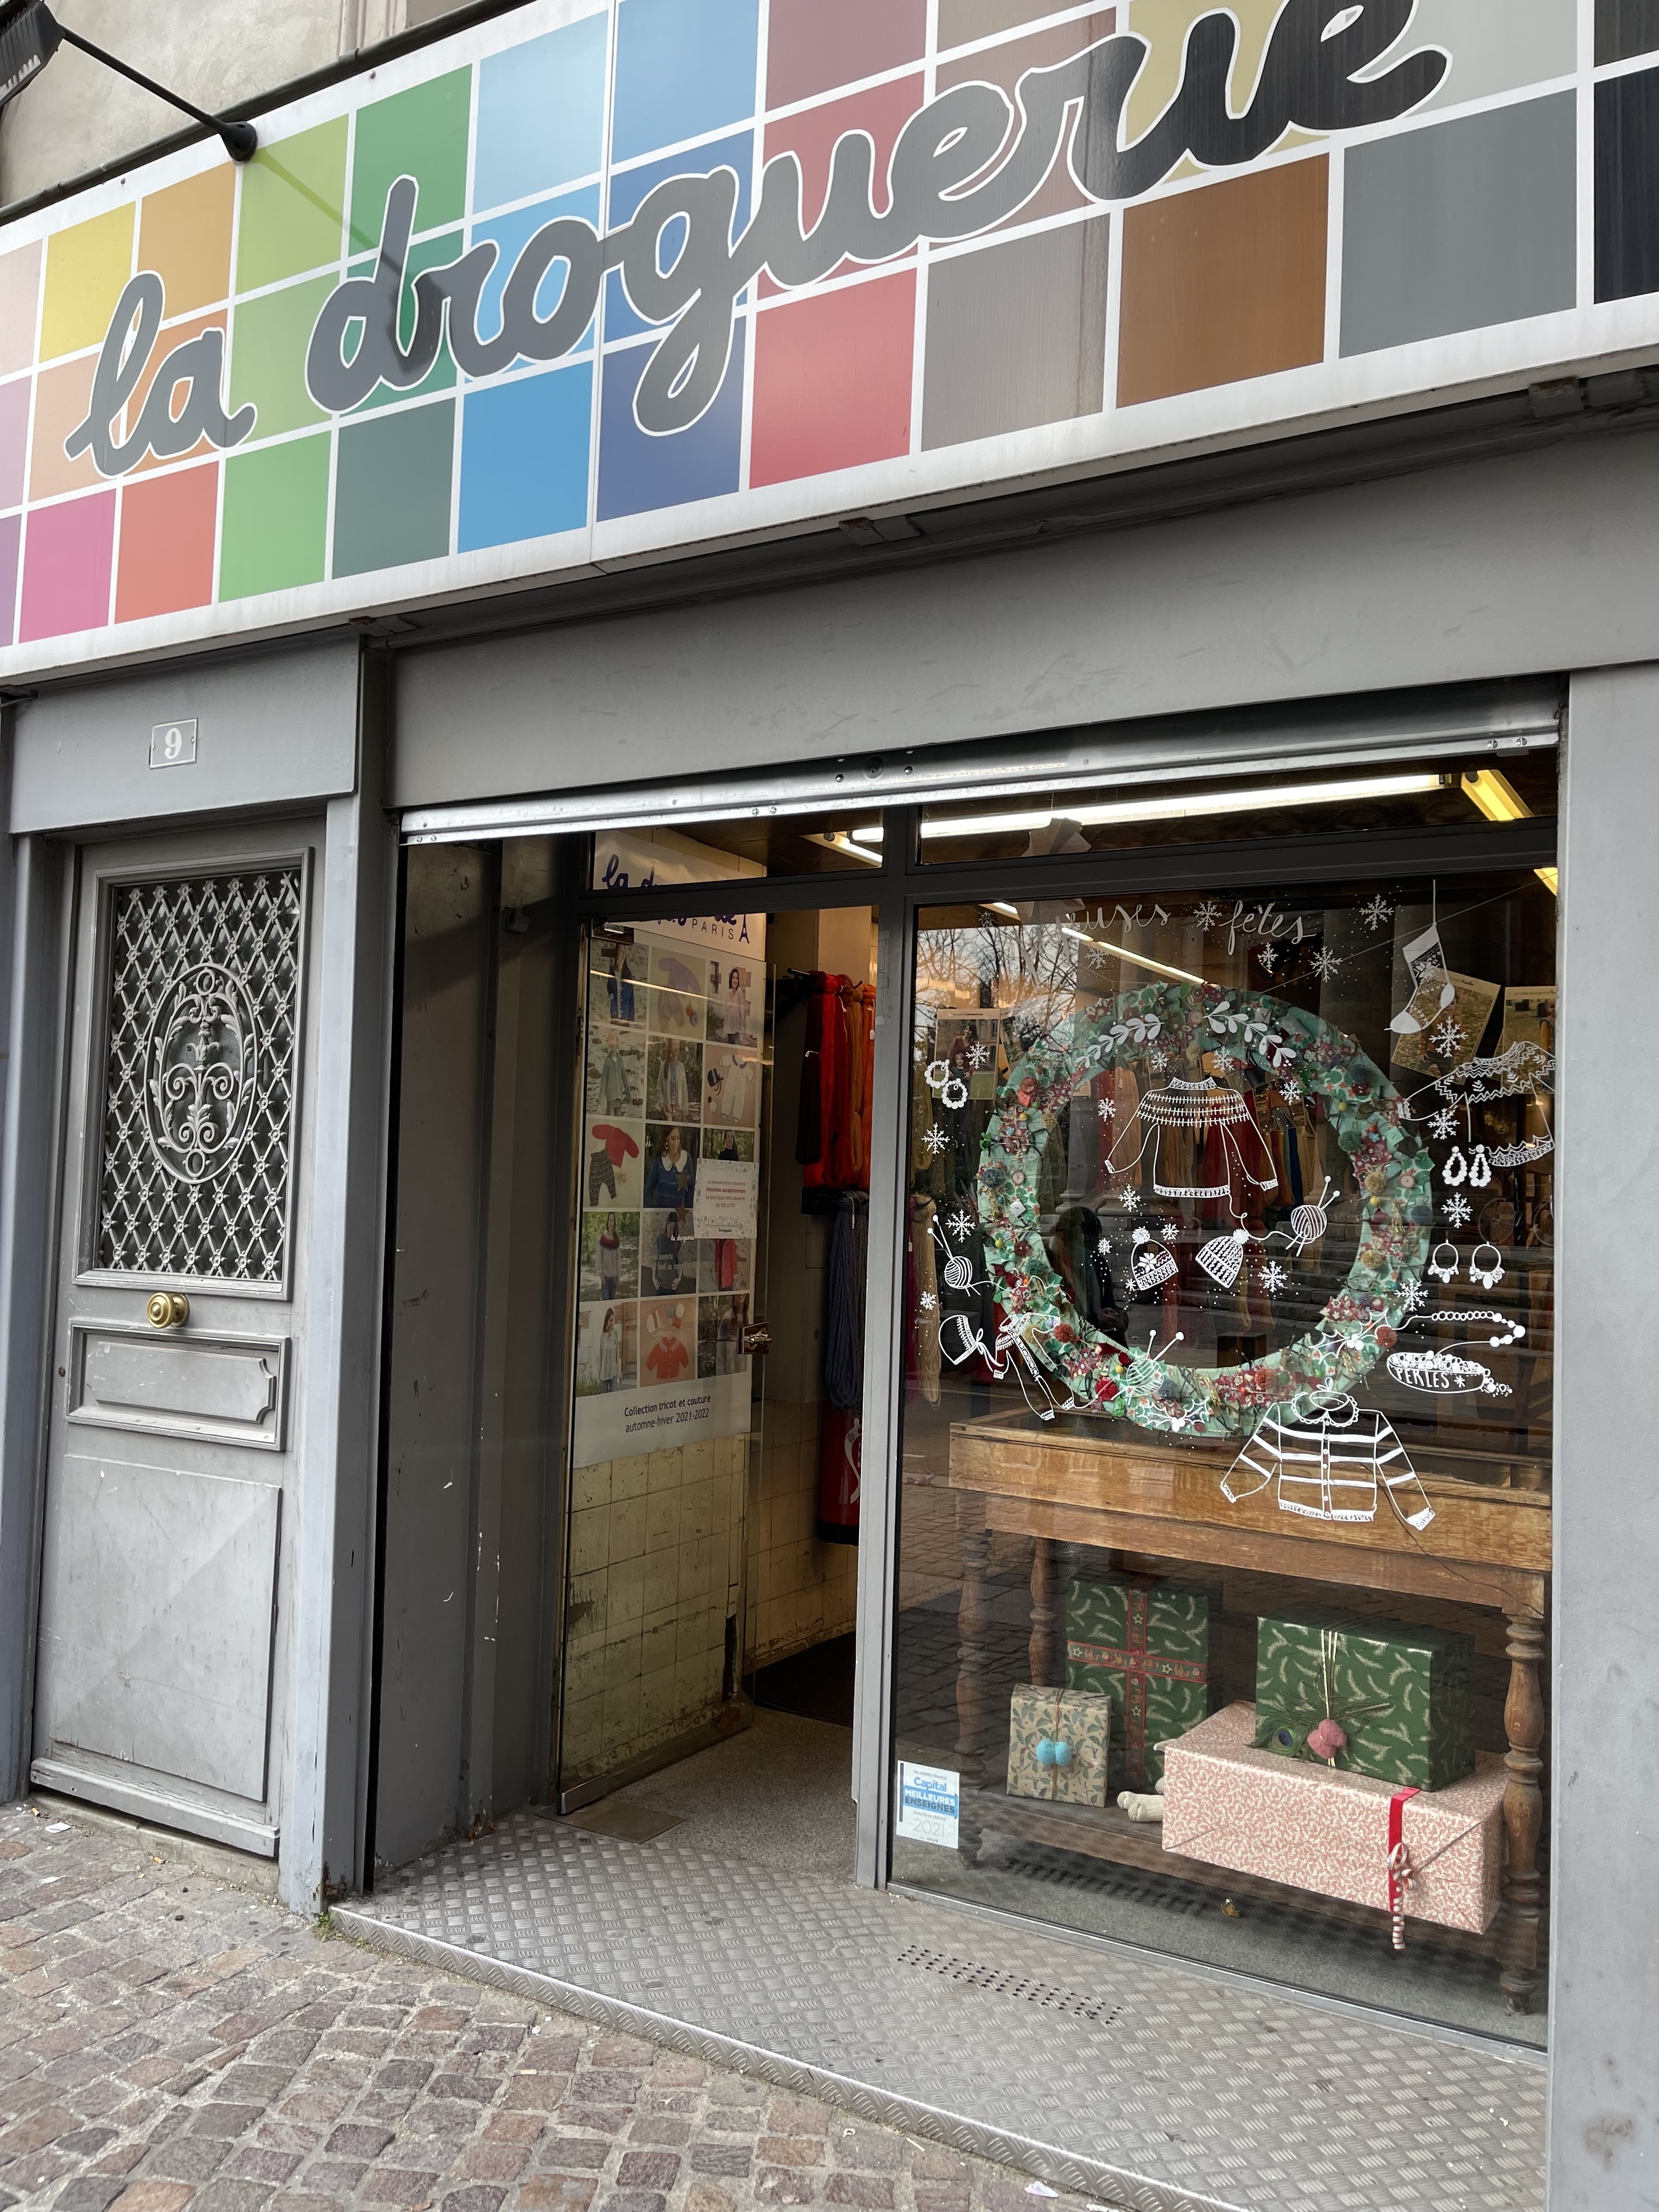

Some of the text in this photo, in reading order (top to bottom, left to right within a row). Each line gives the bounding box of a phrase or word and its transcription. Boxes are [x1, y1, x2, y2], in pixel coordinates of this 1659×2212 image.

[64, 270, 257, 478] la
[165, 727, 182, 759] 9
[692, 918, 734, 939] PARIS
[1394, 1368, 1450, 1389] PERLES
[624, 1395, 712, 1417] Collection tricot et couture
[625, 1408, 709, 1433] automne-hiver 2021-2022
[914, 1777, 946, 1792] Capital
[905, 1788, 955, 1806] MEILLEURES
[905, 1796, 955, 1814] ENSEIGNES
[913, 1818, 944, 1837] 2021
